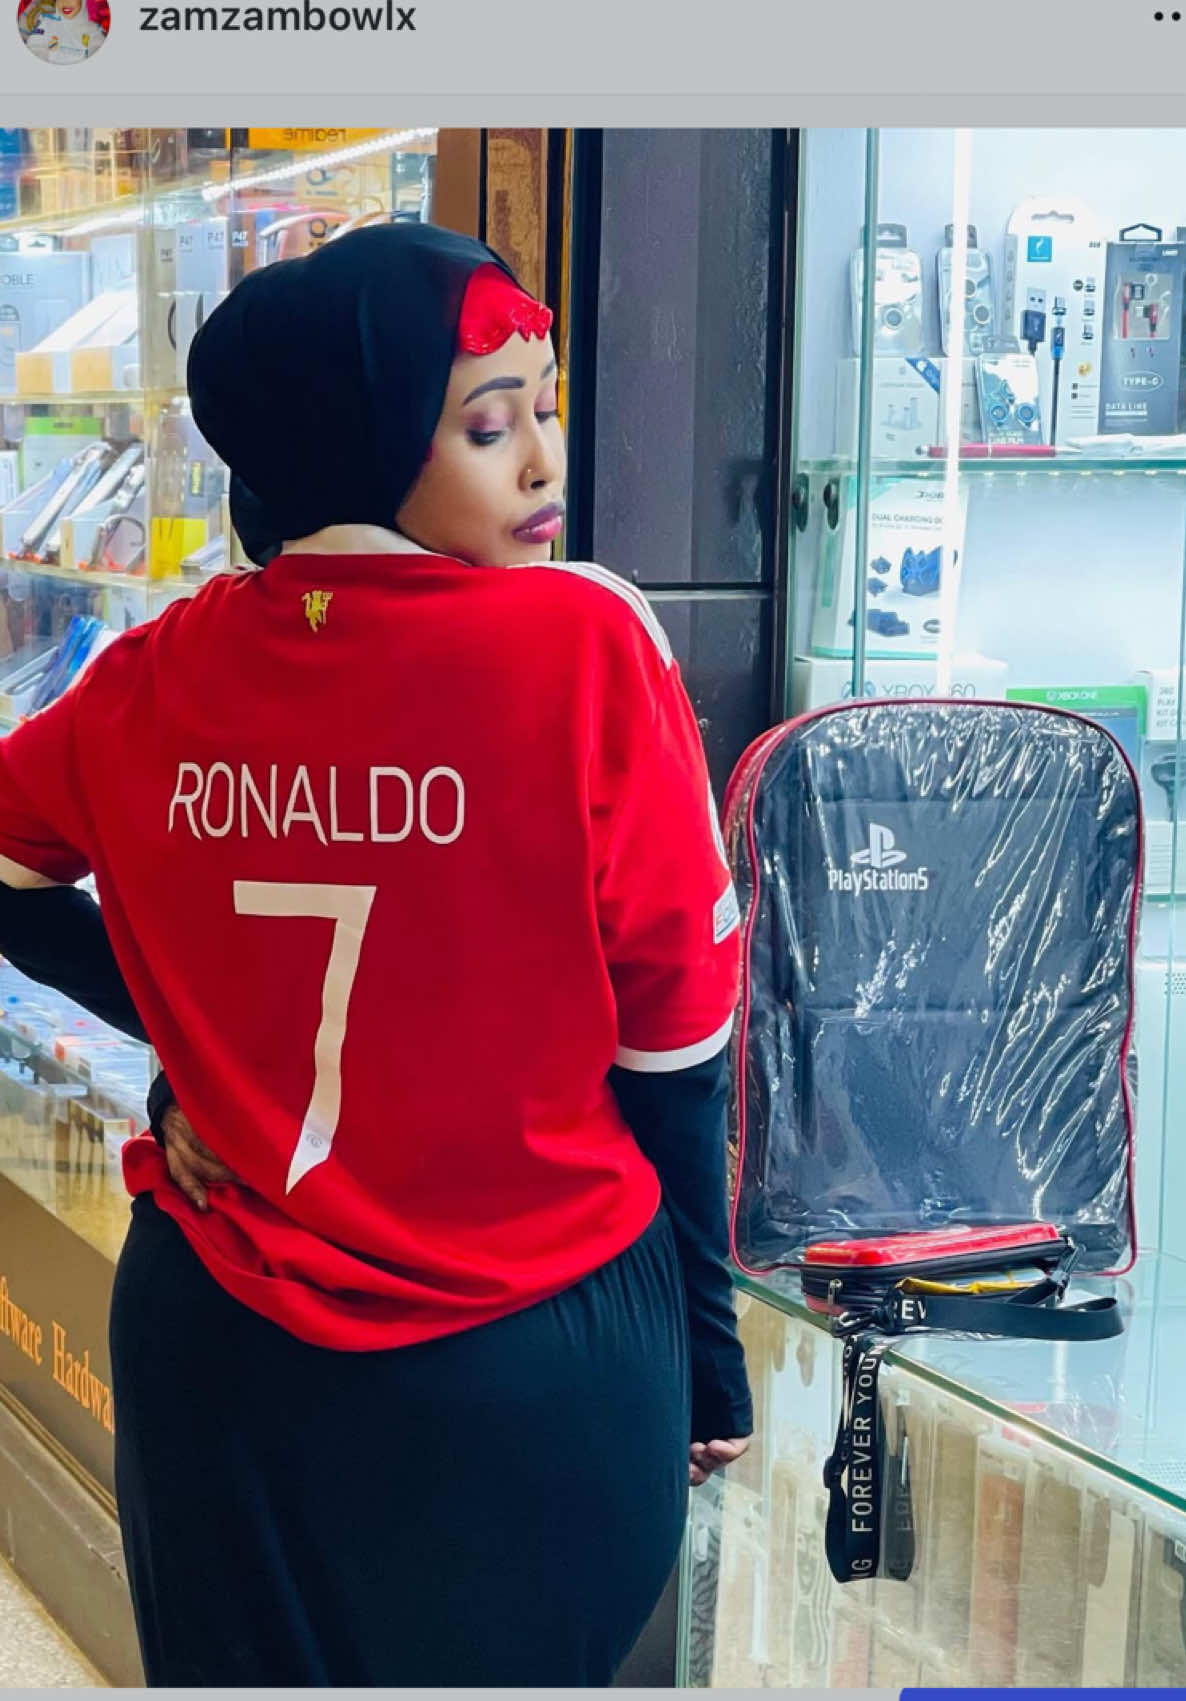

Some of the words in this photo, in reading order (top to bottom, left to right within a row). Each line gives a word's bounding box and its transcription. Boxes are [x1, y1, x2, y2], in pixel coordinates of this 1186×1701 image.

[1122, 375, 1160, 386] TYPE-C
[946, 682, 977, 698] 60
[168, 761, 465, 847] RONALDO
[233, 880, 377, 1196] 7
[851, 1416, 873, 1533] FOREVER
